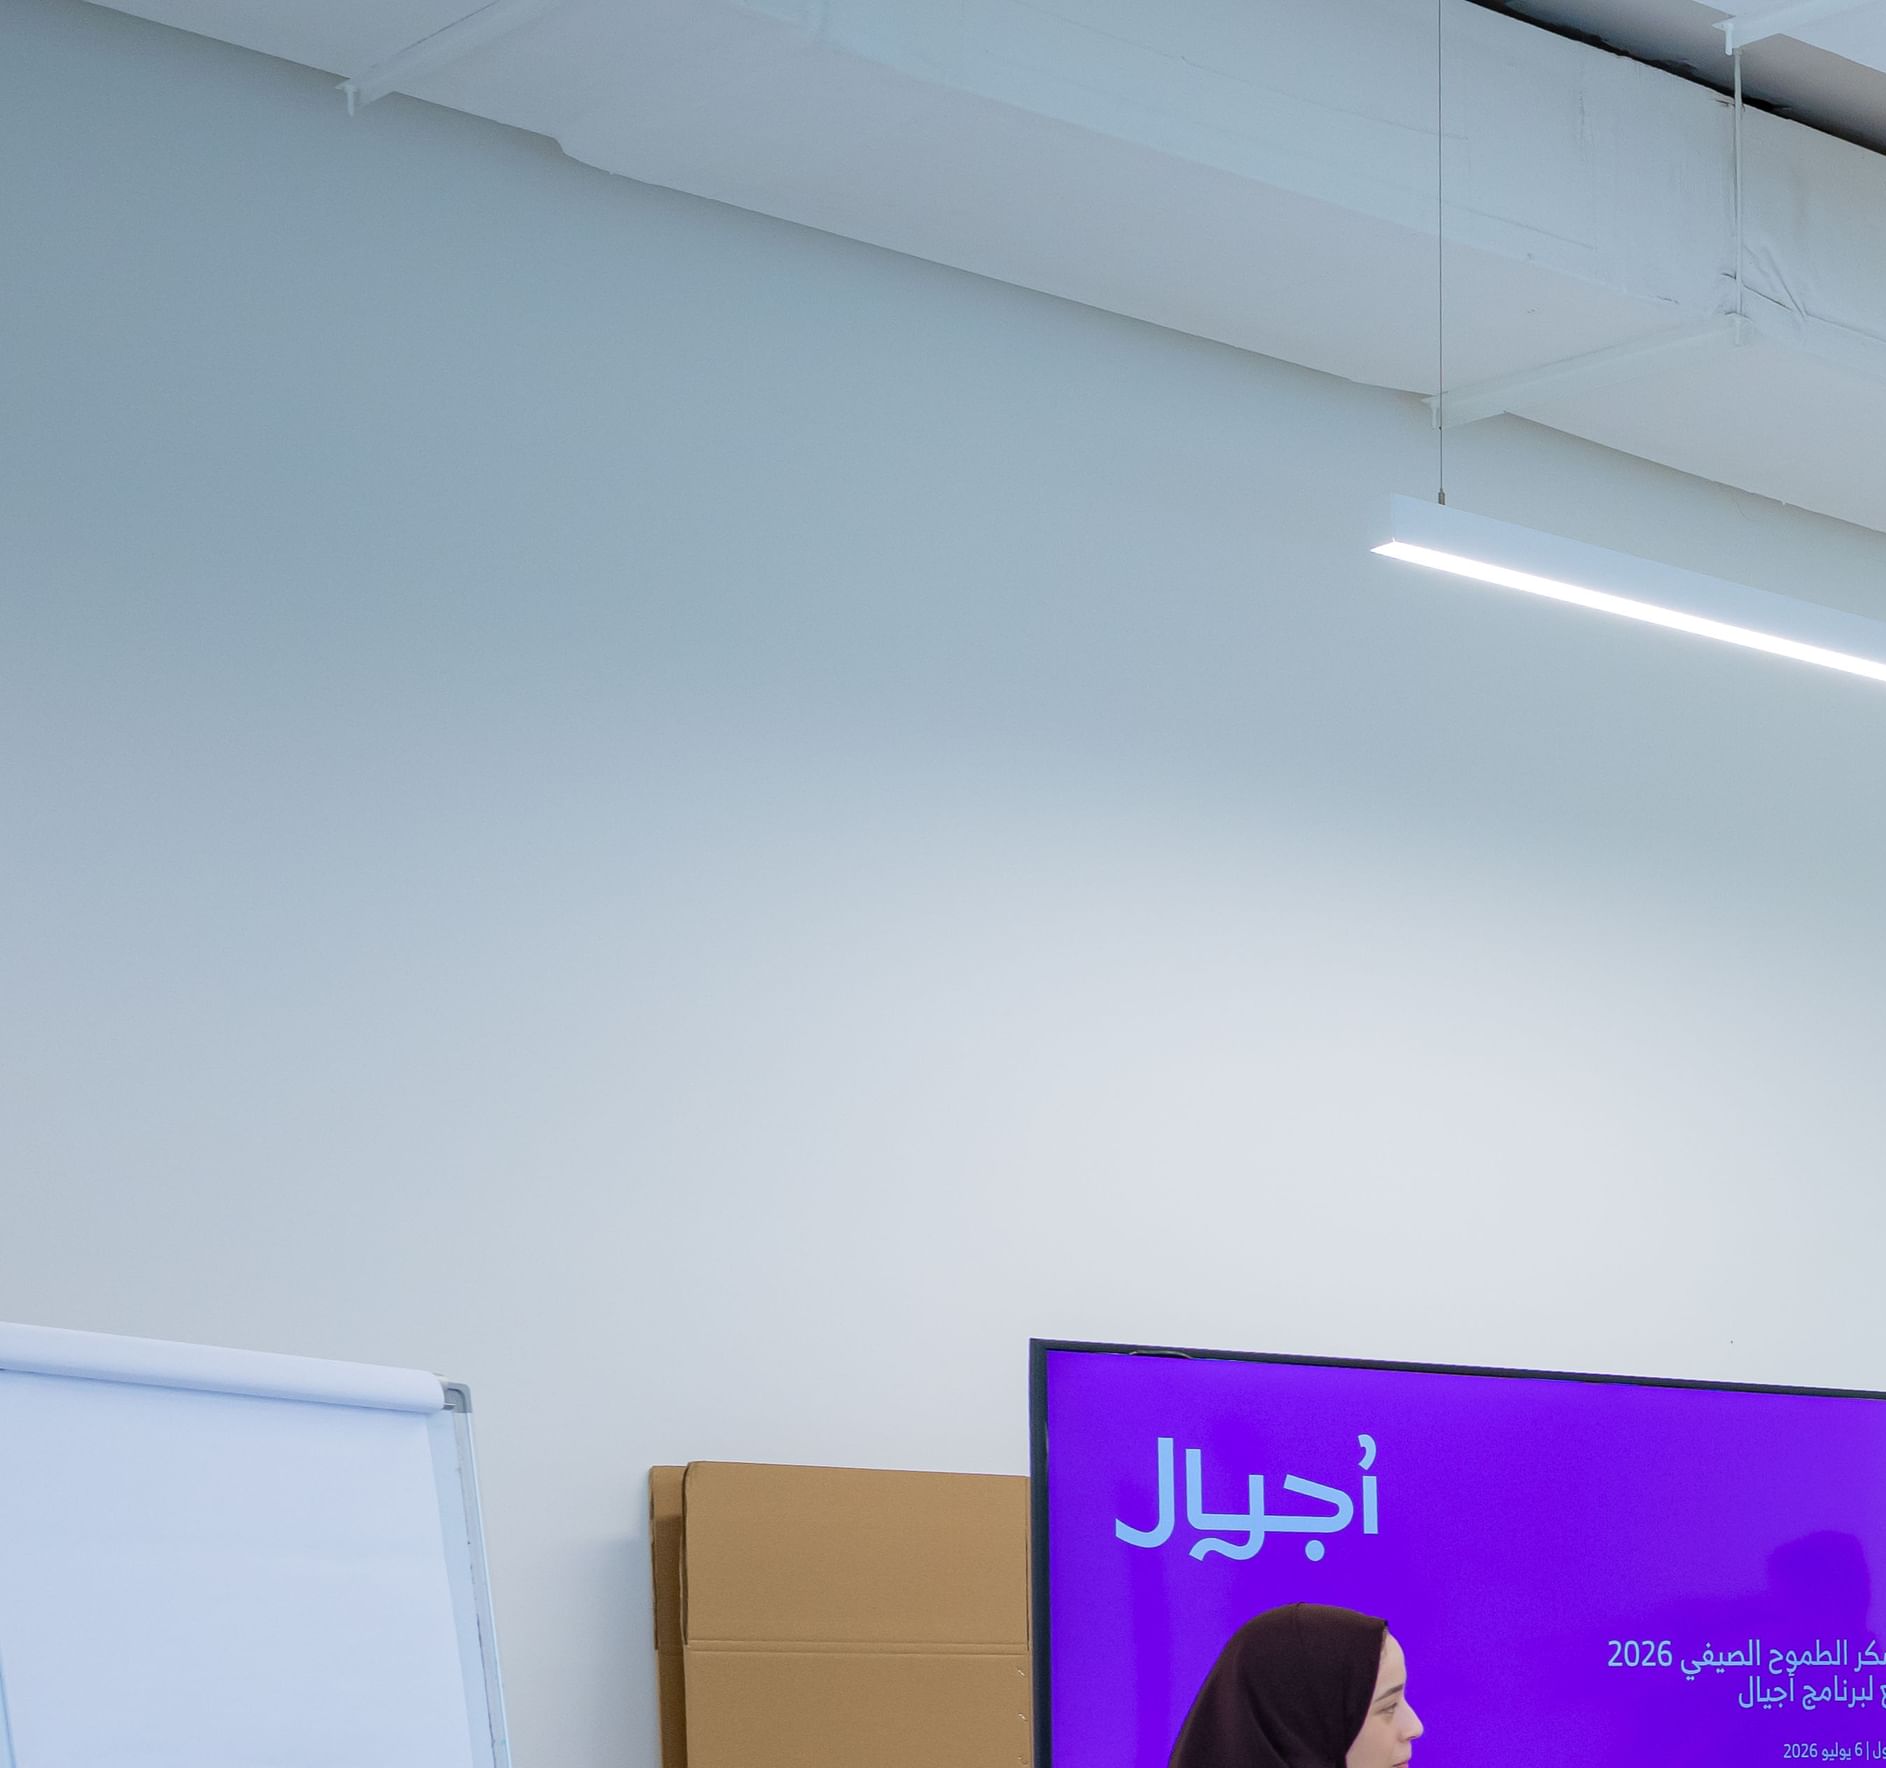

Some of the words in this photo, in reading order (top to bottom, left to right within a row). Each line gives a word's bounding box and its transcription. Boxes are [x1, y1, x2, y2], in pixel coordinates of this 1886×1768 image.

[1115, 1433, 1379, 1562] أجيال
[1607, 1640, 1673, 1667] 2026
[1680, 1639, 1760, 1680] الصيفي
[1768, 1639, 1848, 1674] الطموح
[1738, 1670, 1794, 1709] أجيال
[1802, 1675, 1873, 1710] لبرنامج
[1783, 1743, 1819, 1760] 2026
[1821, 1744, 1852, 1762] يوليو
[1854, 1742, 1863, 1758] 6
